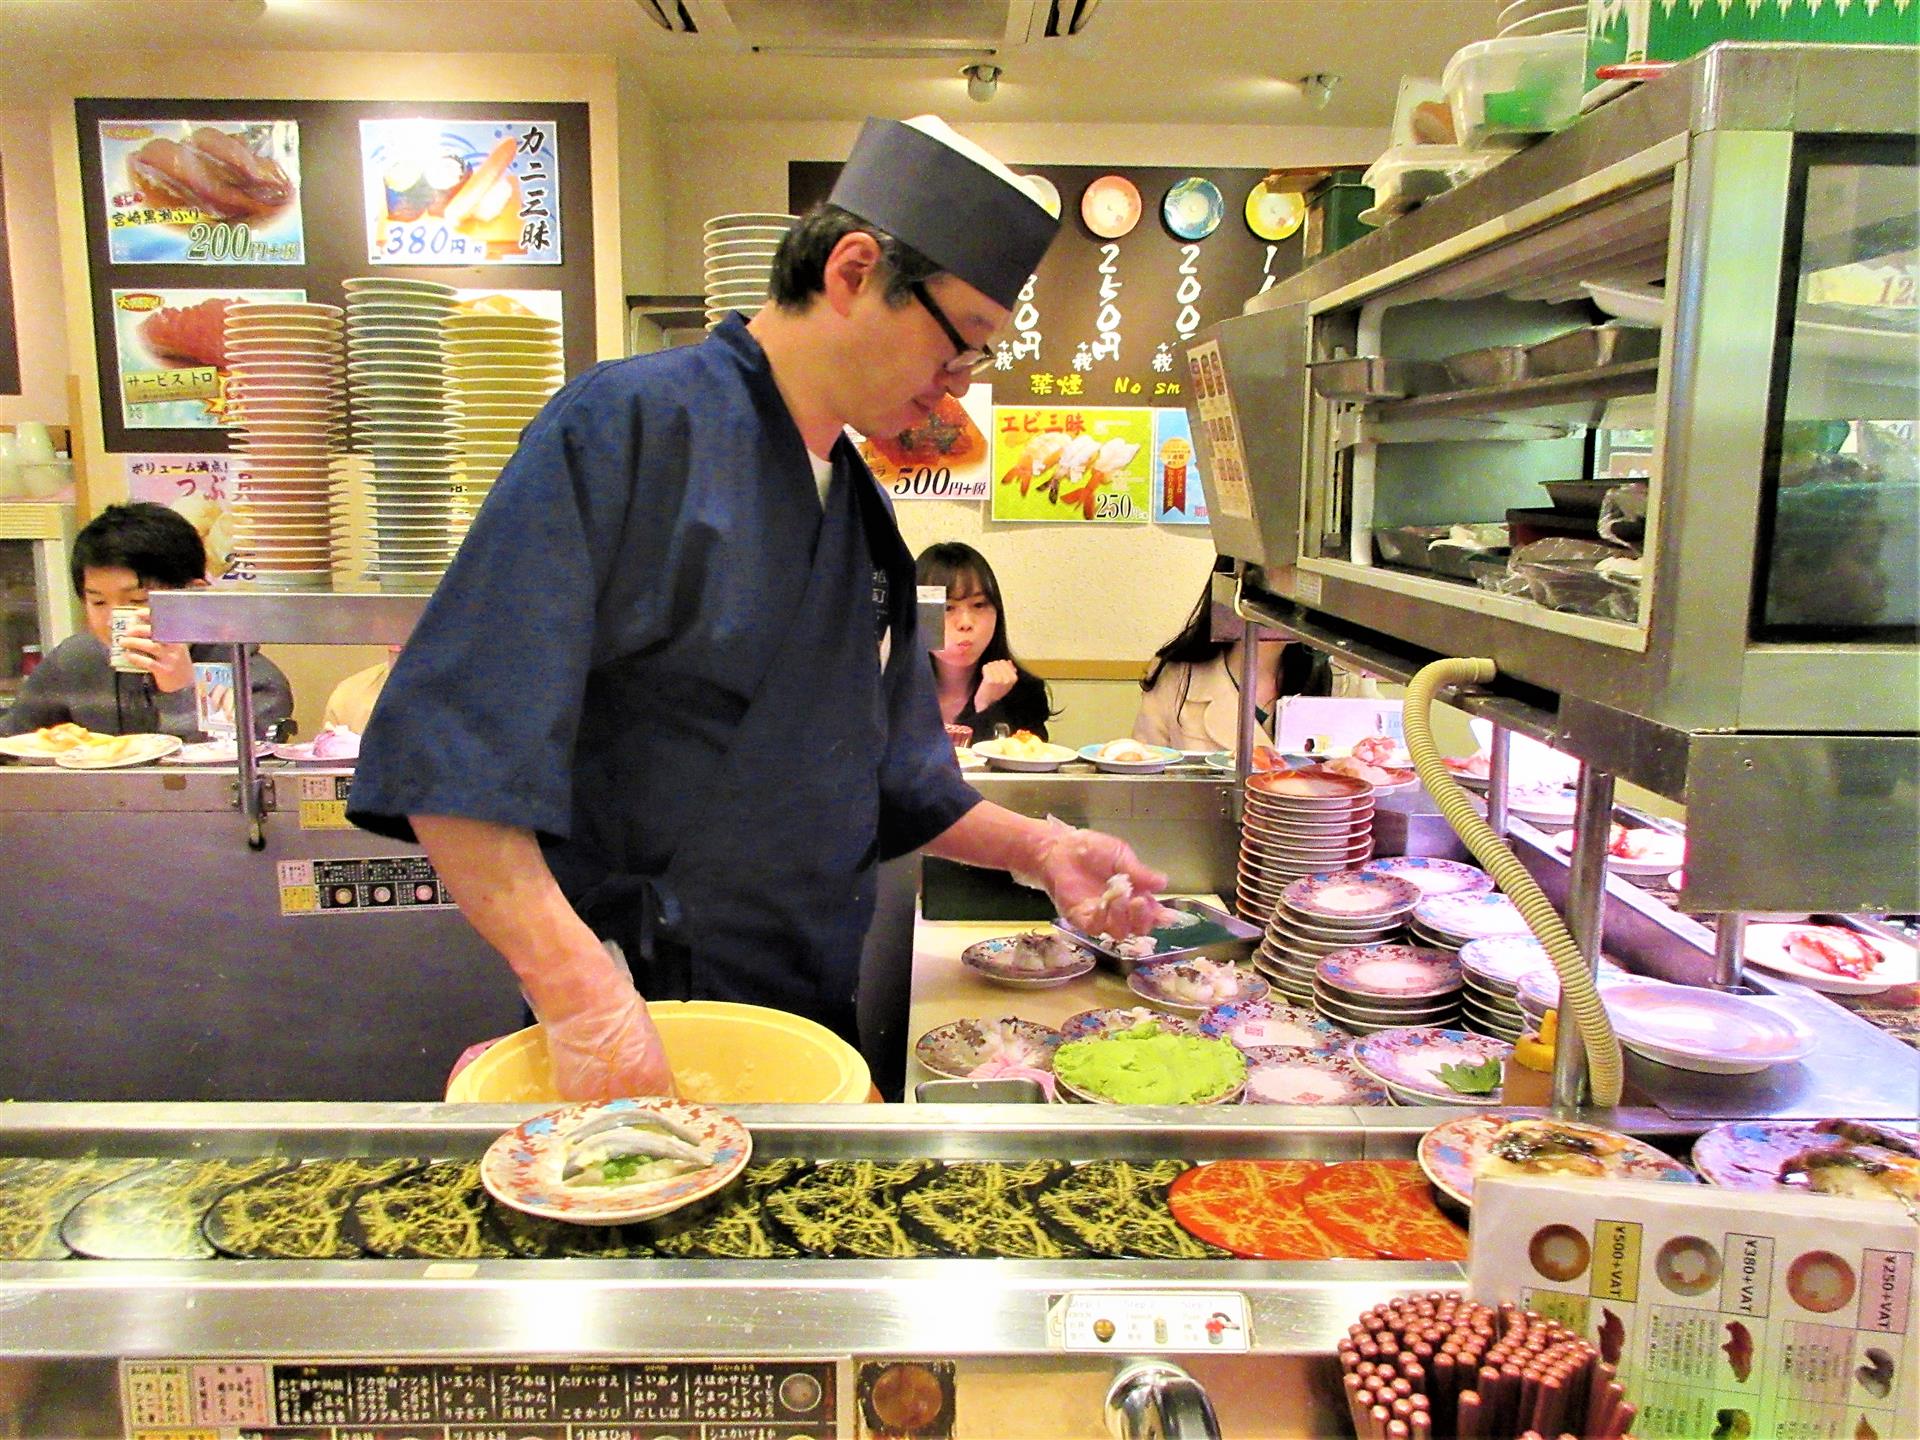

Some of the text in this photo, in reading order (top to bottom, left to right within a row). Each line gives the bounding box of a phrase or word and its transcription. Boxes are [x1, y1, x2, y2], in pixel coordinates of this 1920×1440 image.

[518, 126, 550, 250] カニ三昧
[387, 226, 466, 255] 380円
[1092, 243, 1123, 361] 250円
[1172, 244, 1202, 341] 200
[1030, 373, 1084, 396] 禁煙
[1114, 376, 1142, 395] No
[1000, 412, 1086, 435] エビ三昧
[894, 467, 988, 496] 500円+税
[1609, 1226, 1627, 1299] ¥500+VAT
[1739, 1237, 1758, 1313] ¥380+VAT
[1877, 1255, 1897, 1330] ¥250+VAT
